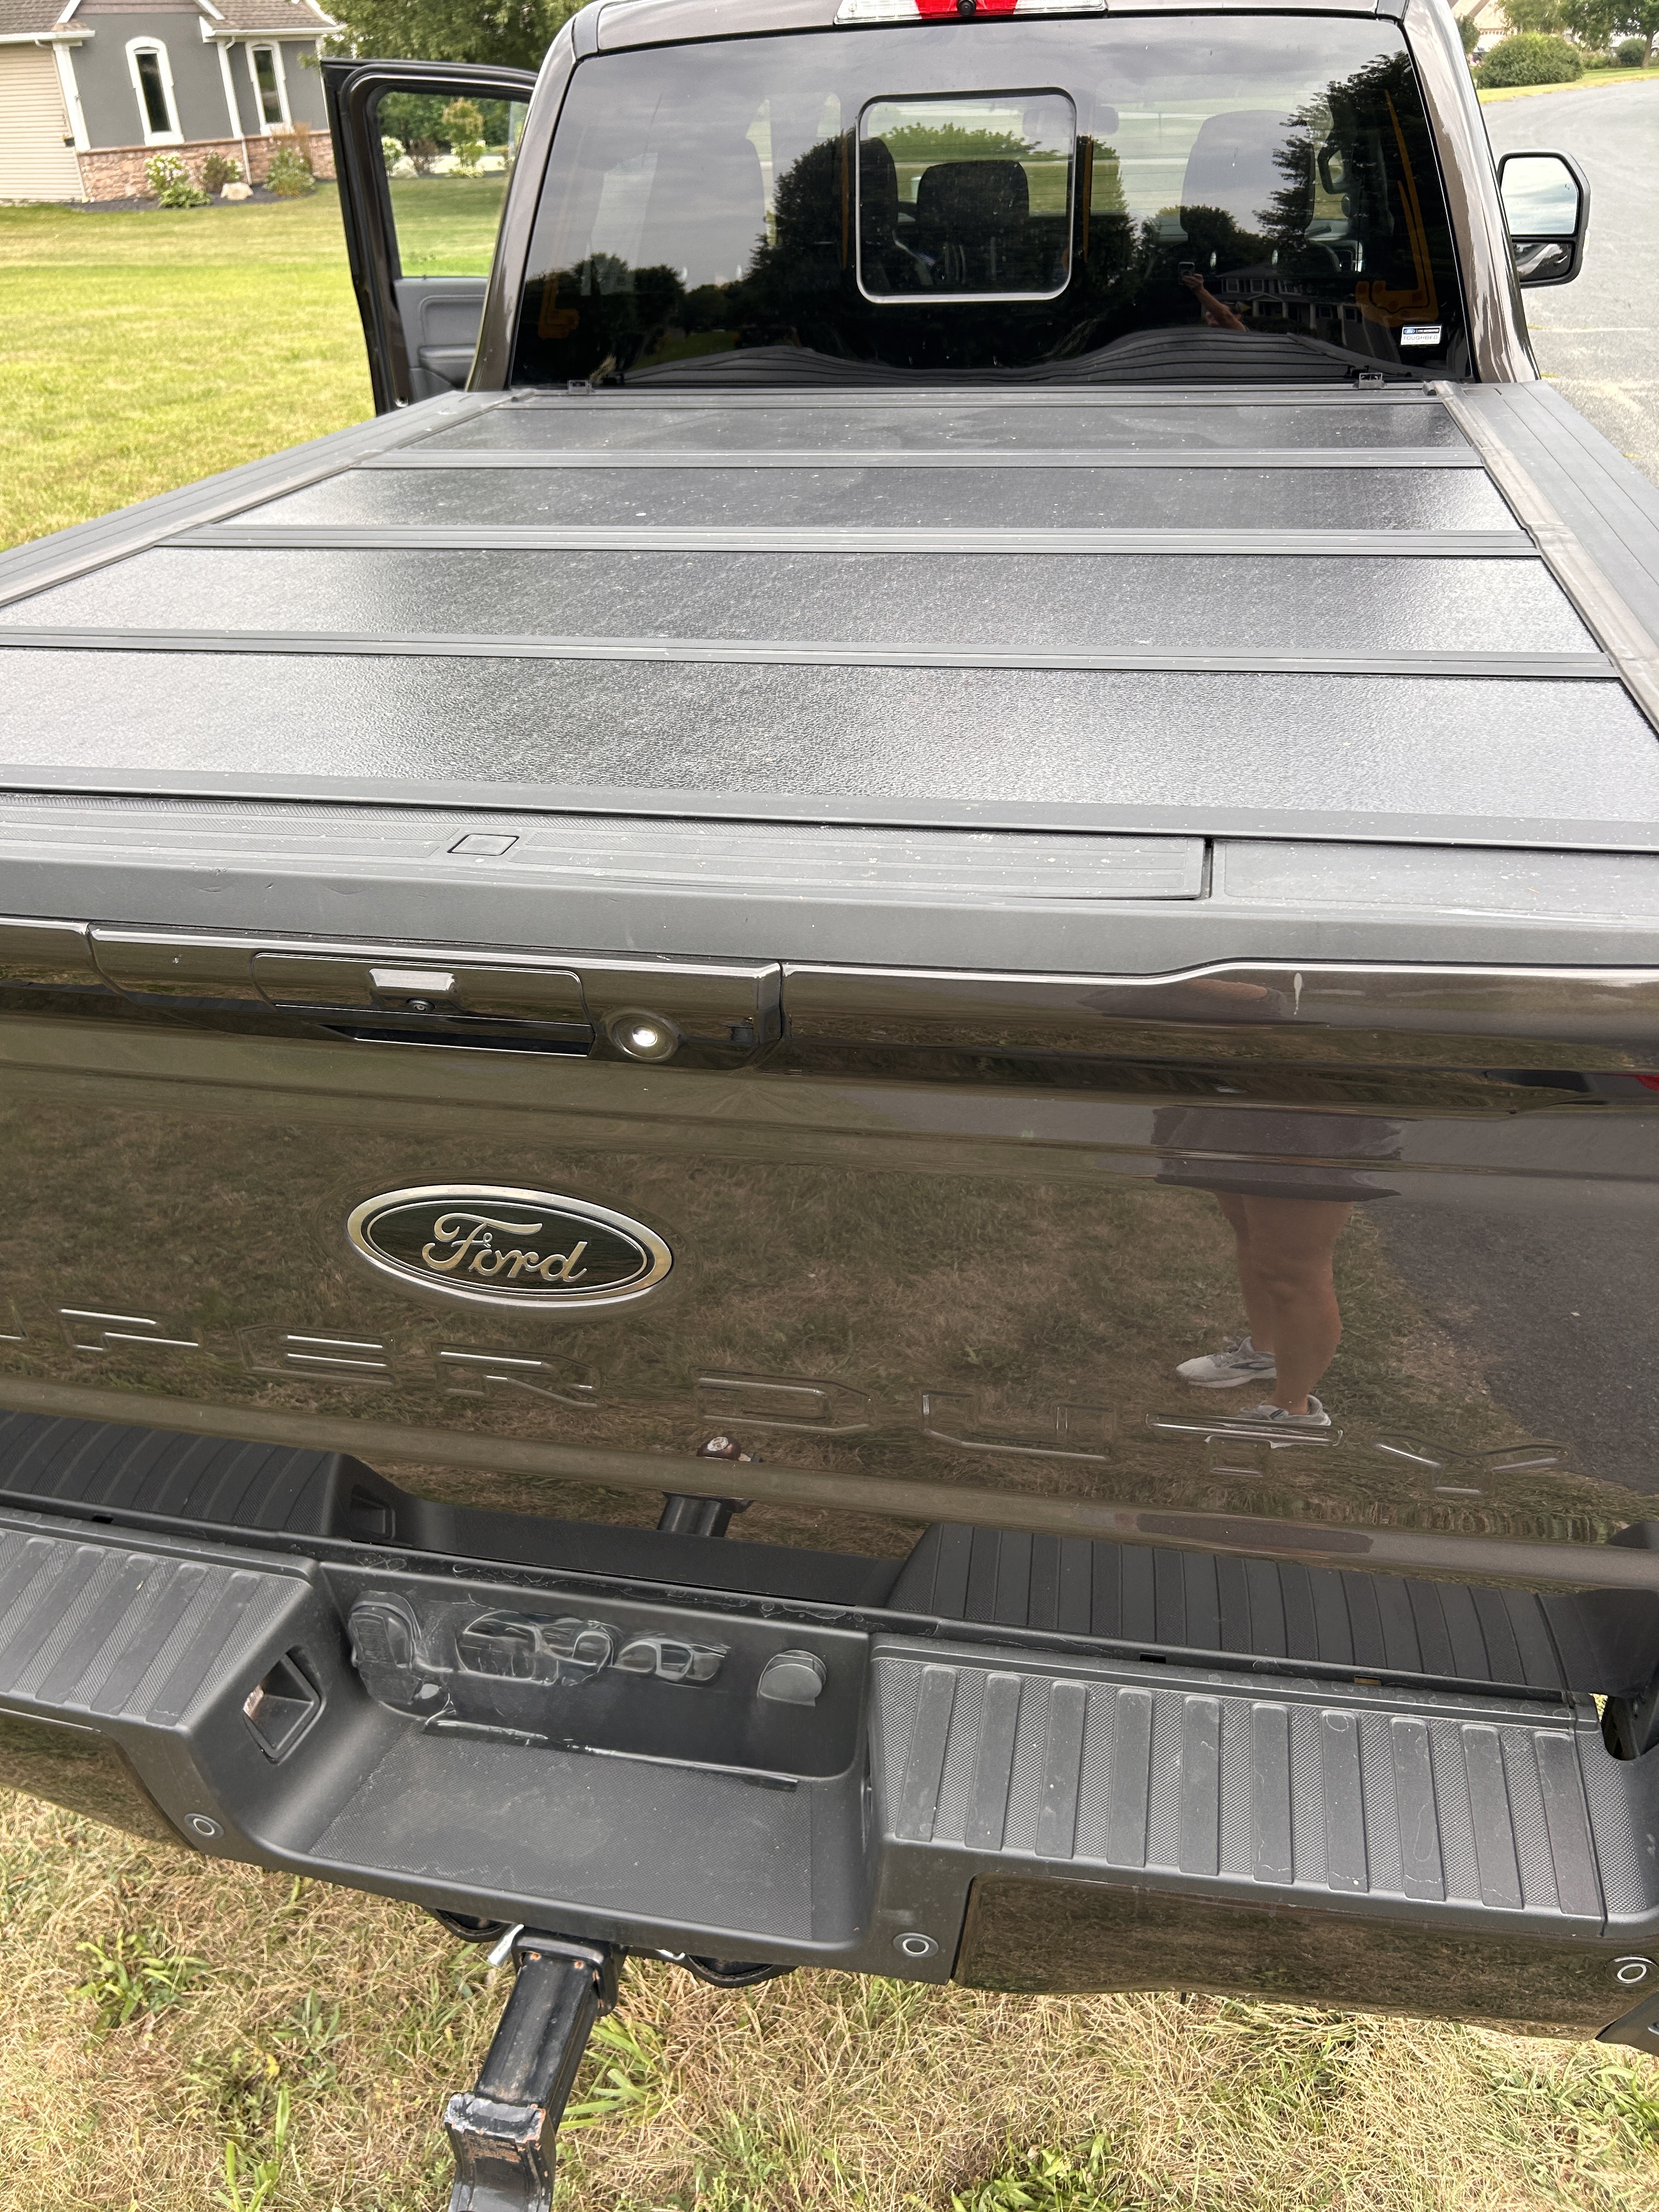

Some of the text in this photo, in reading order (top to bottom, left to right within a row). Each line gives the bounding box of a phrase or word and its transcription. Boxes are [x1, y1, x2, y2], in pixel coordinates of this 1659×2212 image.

[421, 1212, 588, 1282] Ford
[0, 1297, 1573, 1495] PER DUTY
